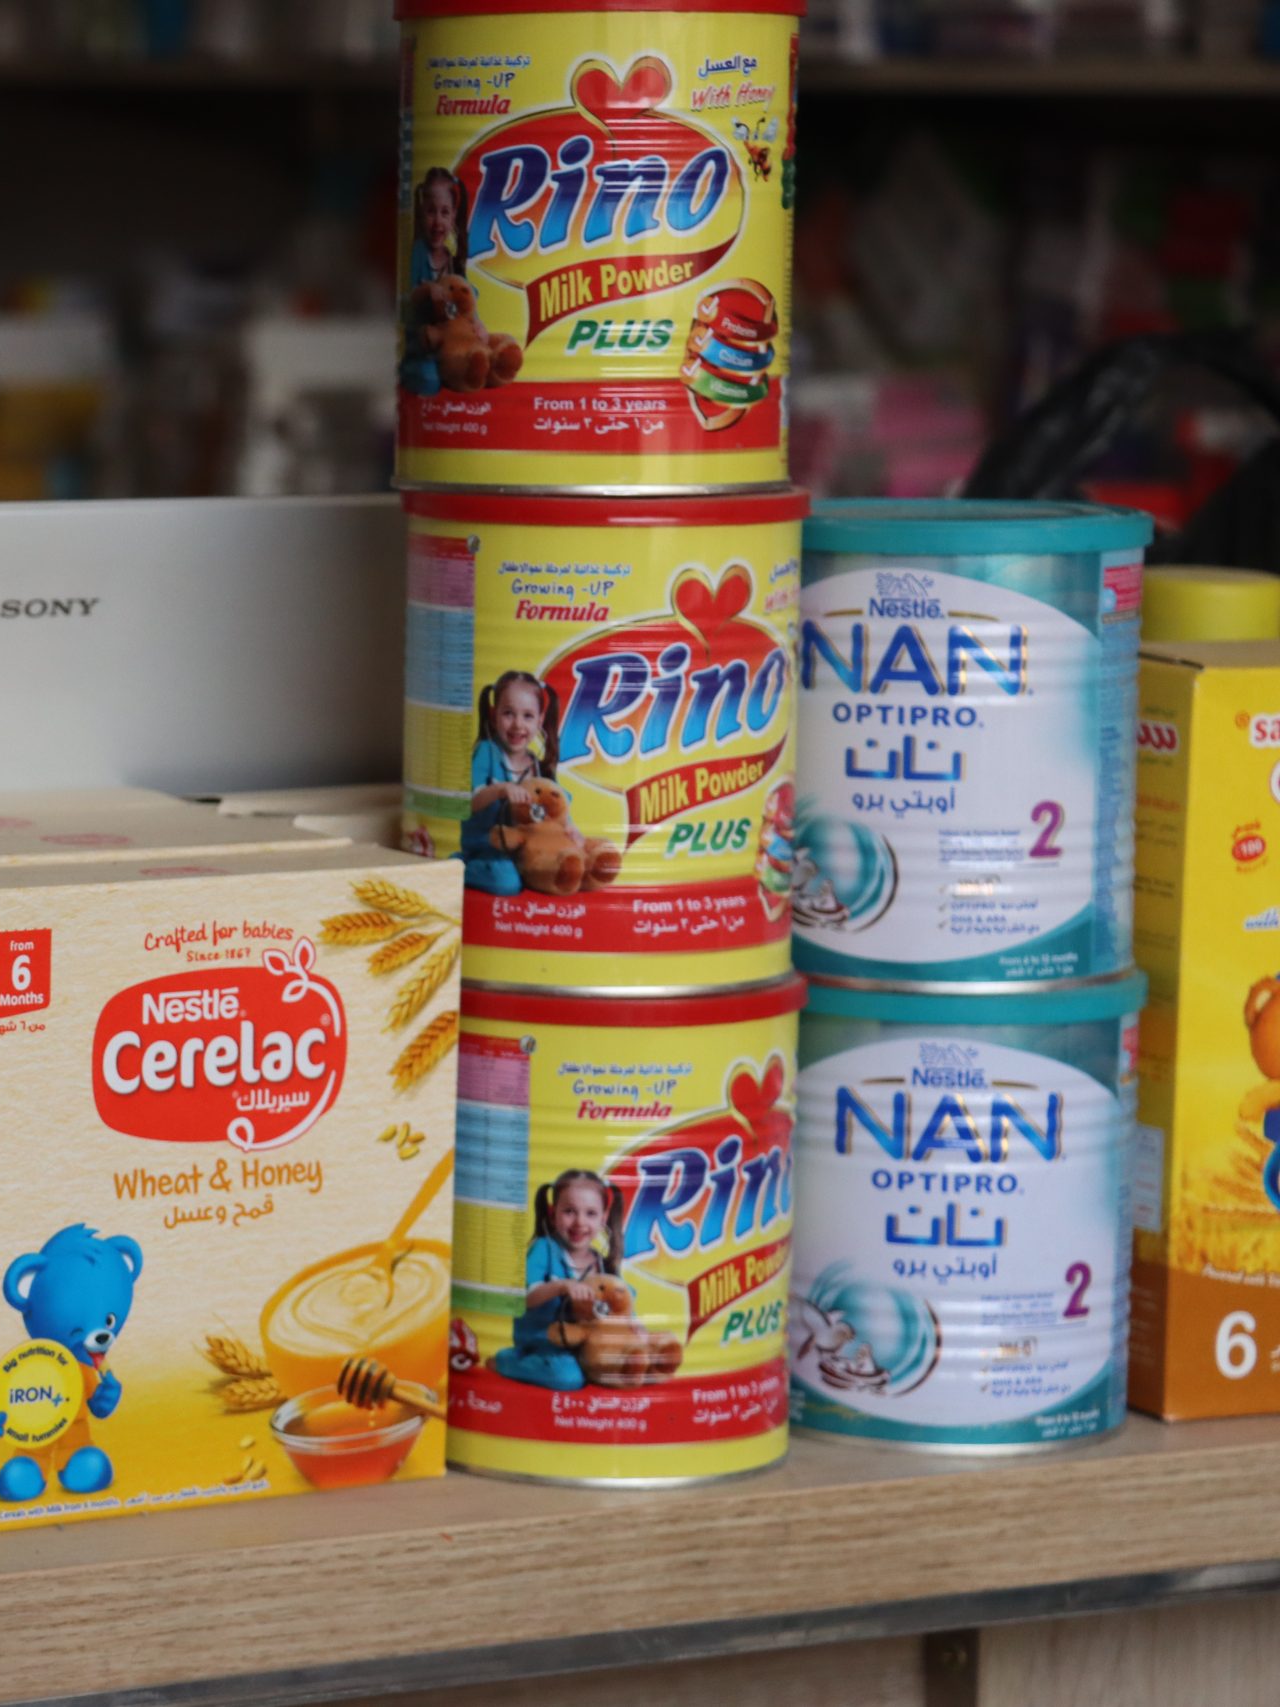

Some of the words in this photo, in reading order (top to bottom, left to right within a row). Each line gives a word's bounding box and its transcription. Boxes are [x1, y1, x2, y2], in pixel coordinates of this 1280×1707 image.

[699, 56, 740, 77] العسل
[743, 57, 757, 74] مع
[436, 94, 511, 115] Formula
[468, 135, 730, 258] Rino
[540, 269, 592, 322] Milk
[601, 260, 694, 298] Powder
[567, 320, 674, 351] PLUS
[534, 398, 573, 410] From
[580, 398, 586, 410] 1
[593, 398, 608, 410] to
[626, 399, 666, 413] years
[512, 579, 574, 601] Growing
[0, 598, 100, 619] SONY
[516, 599, 609, 621] Formula
[802, 619, 1029, 696] NAN
[558, 643, 785, 763] Rino
[832, 703, 977, 728] OPTIPRO
[845, 735, 962, 781] نان
[640, 781, 688, 825] Milk
[695, 760, 763, 798] Powder
[668, 819, 751, 854] PLUS
[1028, 800, 1064, 859] 2
[634, 900, 672, 914] From
[10, 940, 34, 951] from
[144, 926, 208, 953] Crafted
[211, 920, 237, 946] for
[242, 921, 294, 942] babies
[12, 954, 31, 991] 6
[187, 949, 222, 963] Since
[0, 992, 44, 1006] Months
[142, 986, 240, 1026] Nestlé
[102, 1021, 326, 1094] Cerelac
[236, 1088, 309, 1114] سيريلاك
[573, 1079, 639, 1101] Growing
[578, 1099, 672, 1119] Formula
[836, 1086, 1064, 1162] NAN
[114, 1163, 201, 1202] Wheat
[209, 1159, 233, 1191] &
[242, 1158, 322, 1195] Honey
[871, 1169, 1018, 1194] OPTIPRO
[233, 1193, 274, 1224] قمح
[886, 1202, 1005, 1247] نان
[700, 1263, 741, 1318] Milk
[1062, 1260, 1092, 1319] 2
[723, 1300, 783, 1341] PLUS
[1215, 1311, 1257, 1379] 6
